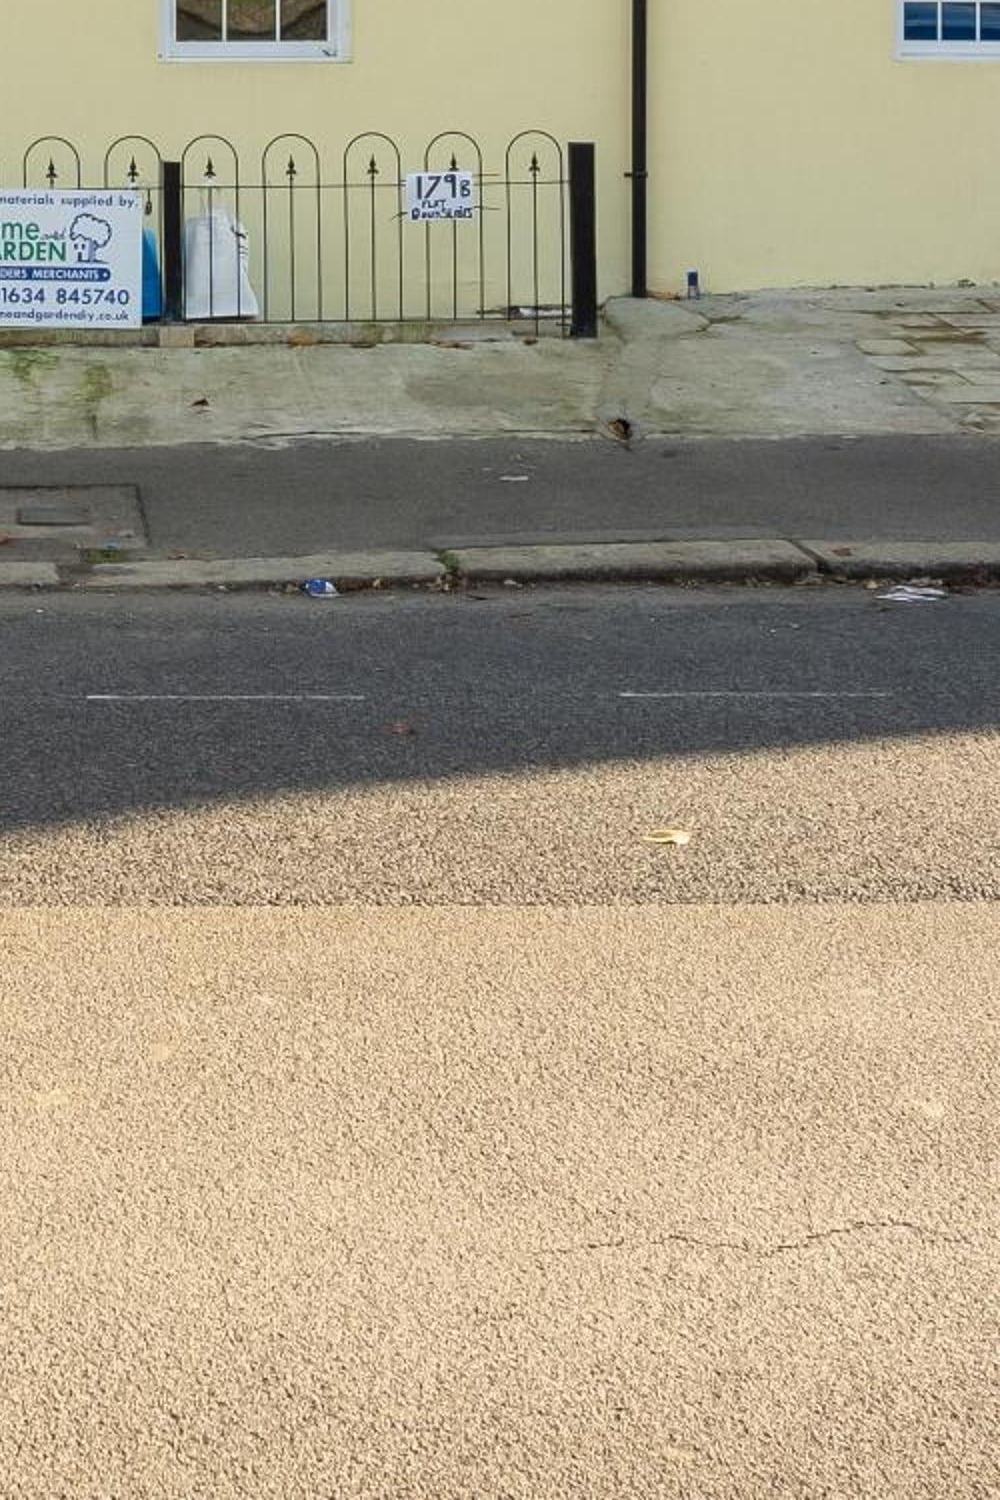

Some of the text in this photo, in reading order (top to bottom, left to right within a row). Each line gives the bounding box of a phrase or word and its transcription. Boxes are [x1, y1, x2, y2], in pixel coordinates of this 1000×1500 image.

[61, 195, 113, 208] supplied
[31, 269, 99, 280] MERCHANTS
[56, 287, 130, 306] 845740
